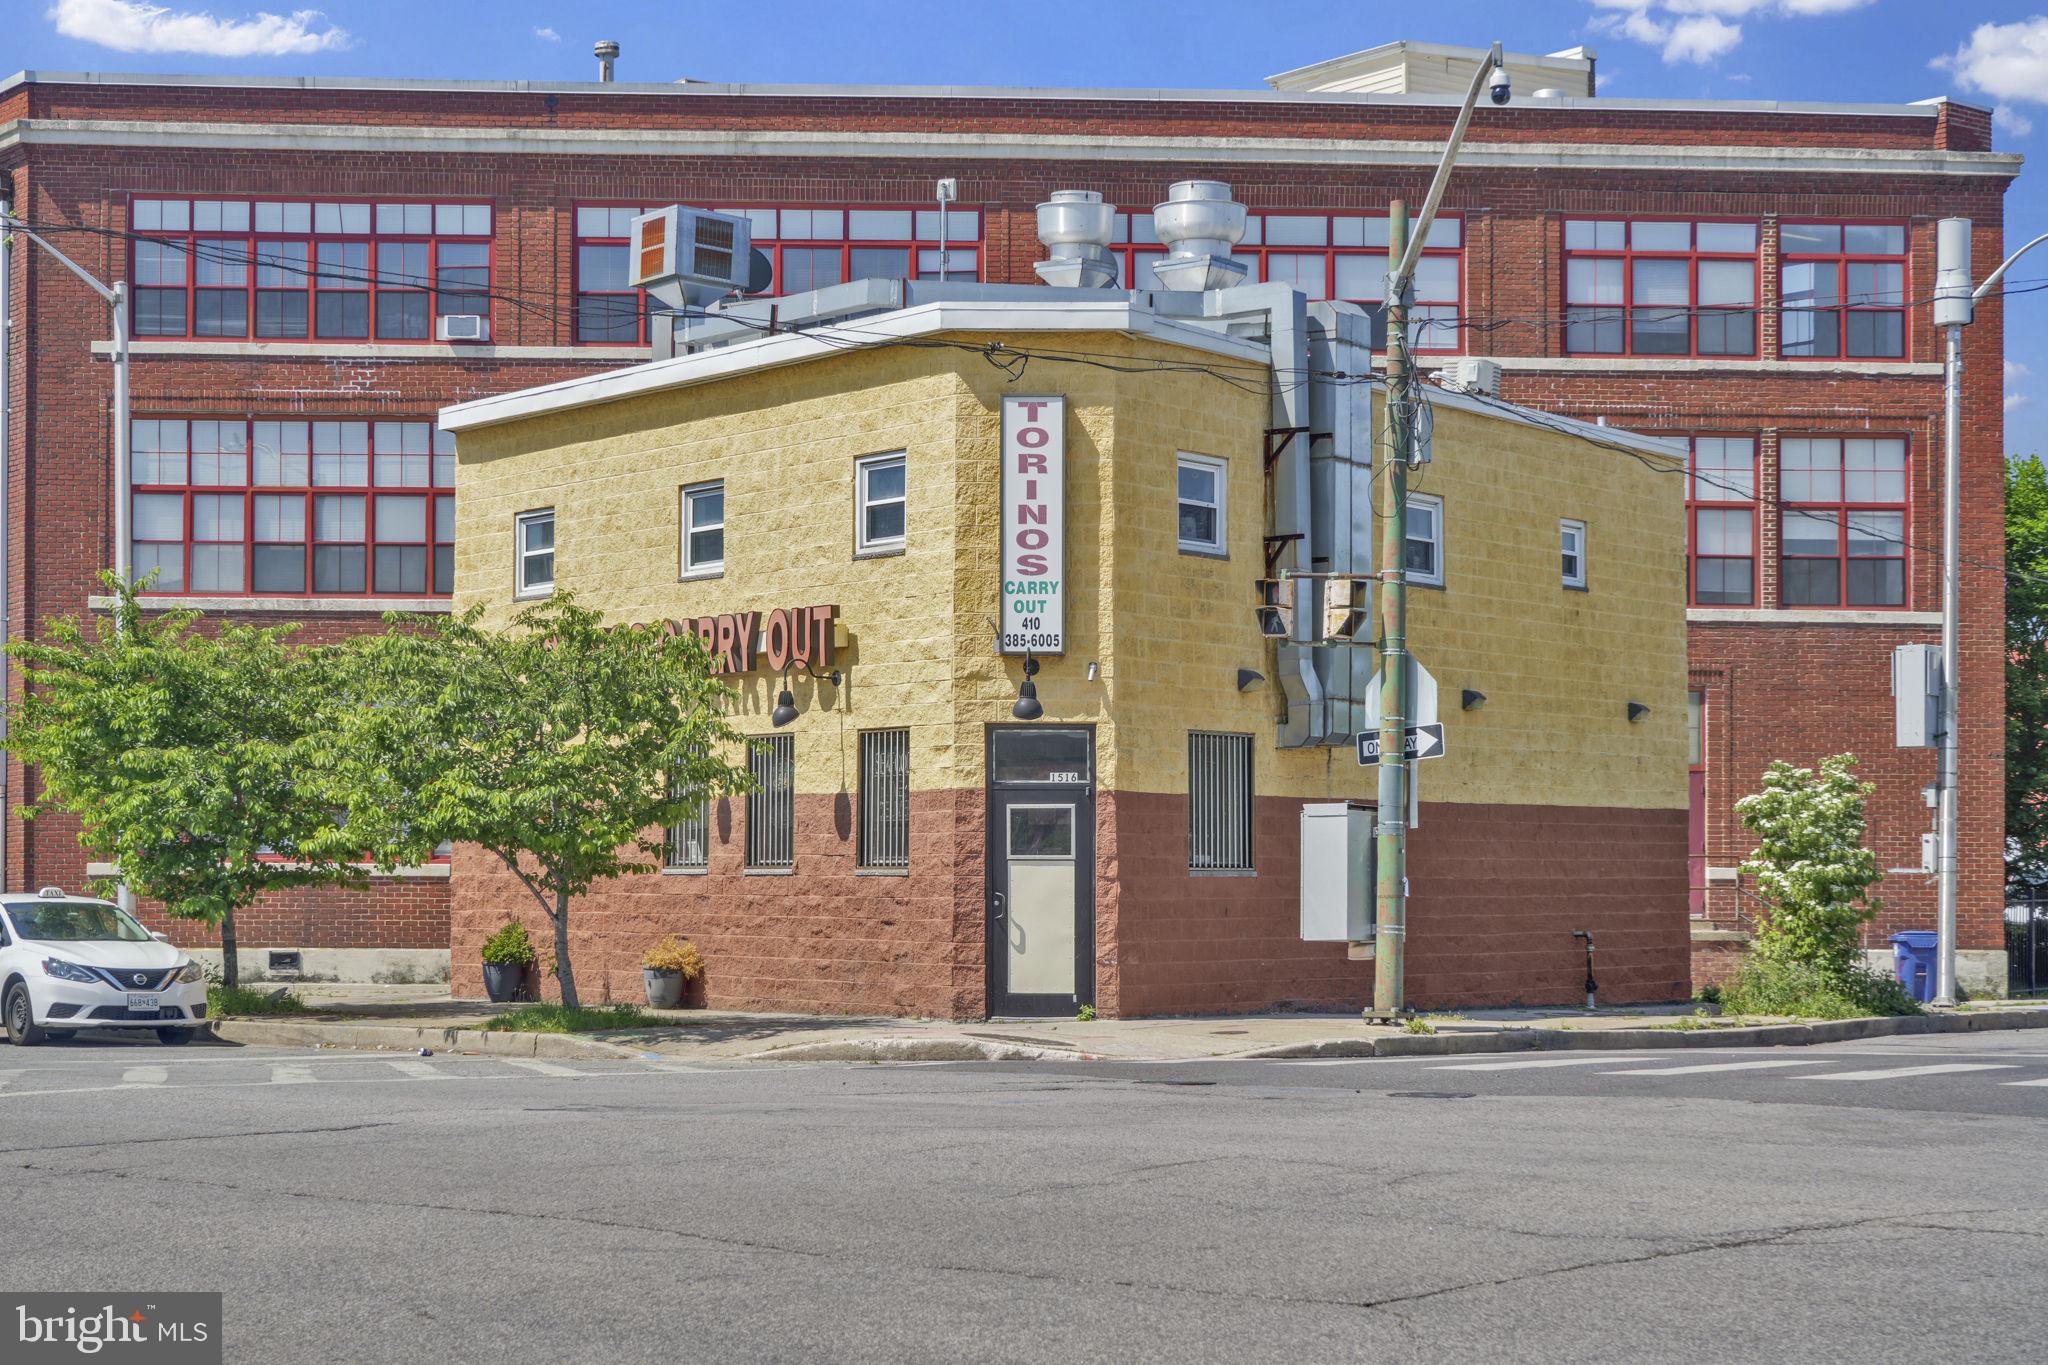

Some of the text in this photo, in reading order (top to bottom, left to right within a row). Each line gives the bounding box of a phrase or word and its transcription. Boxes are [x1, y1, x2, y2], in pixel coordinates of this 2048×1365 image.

[1016, 401, 1049, 576] TORINOS
[1004, 580, 1059, 595] CARRY
[1013, 599, 1047, 614] OUT
[1021, 617, 1041, 631] 410
[656, 611, 756, 674] RRY
[766, 605, 833, 671] OUT
[1051, 773, 1077, 782] 1516
[46, 889, 62, 897] TAXI
